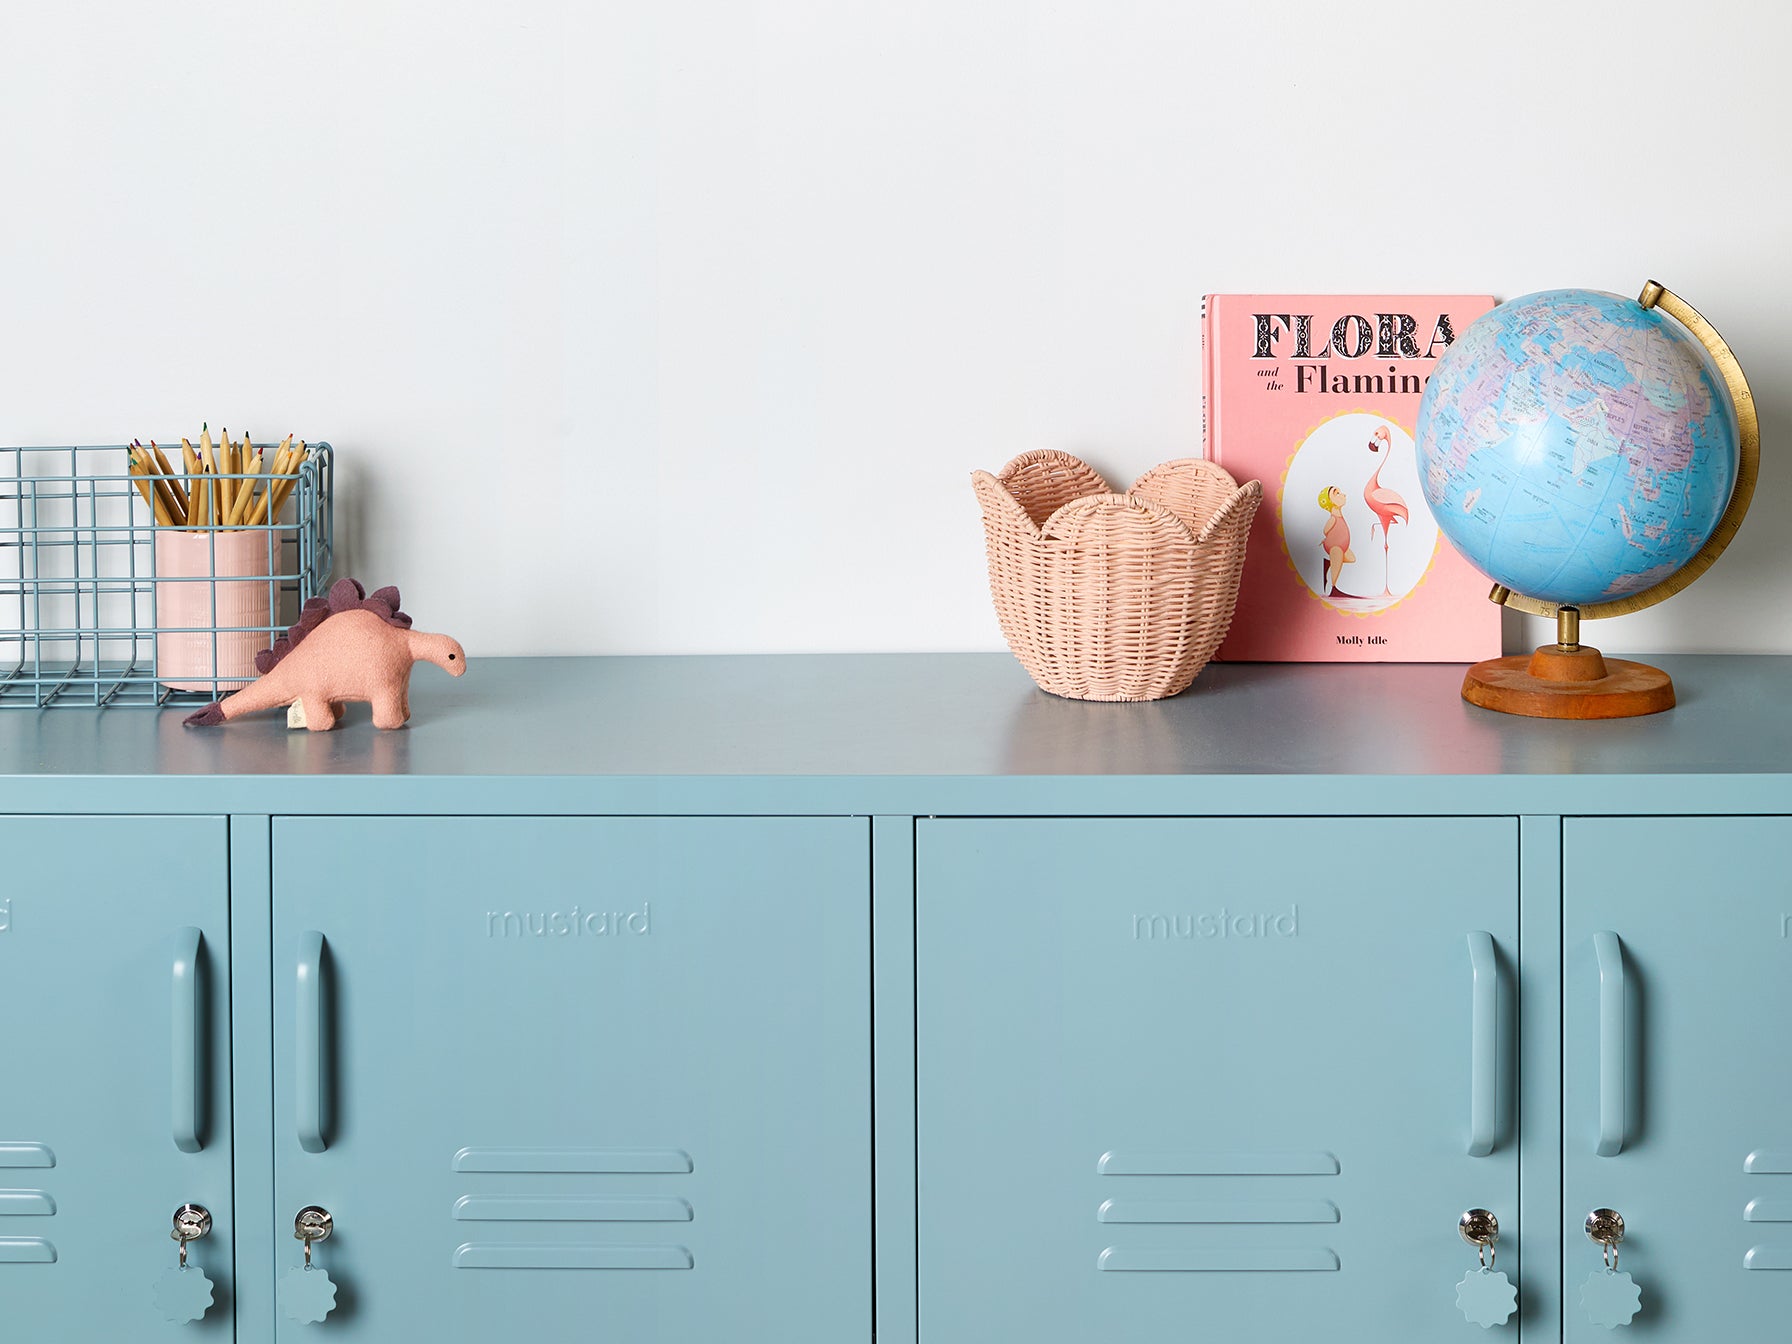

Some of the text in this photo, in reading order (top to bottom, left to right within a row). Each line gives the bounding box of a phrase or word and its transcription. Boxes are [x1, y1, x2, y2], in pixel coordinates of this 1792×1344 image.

[1249, 312, 1456, 360] FLORA
[1257, 366, 1279, 377] and
[1266, 380, 1284, 391] the
[1294, 364, 1430, 394] Flamin
[1336, 635, 1388, 647] Molly Idle
[485, 901, 652, 937] mustard
[1132, 903, 1300, 940] mustard
